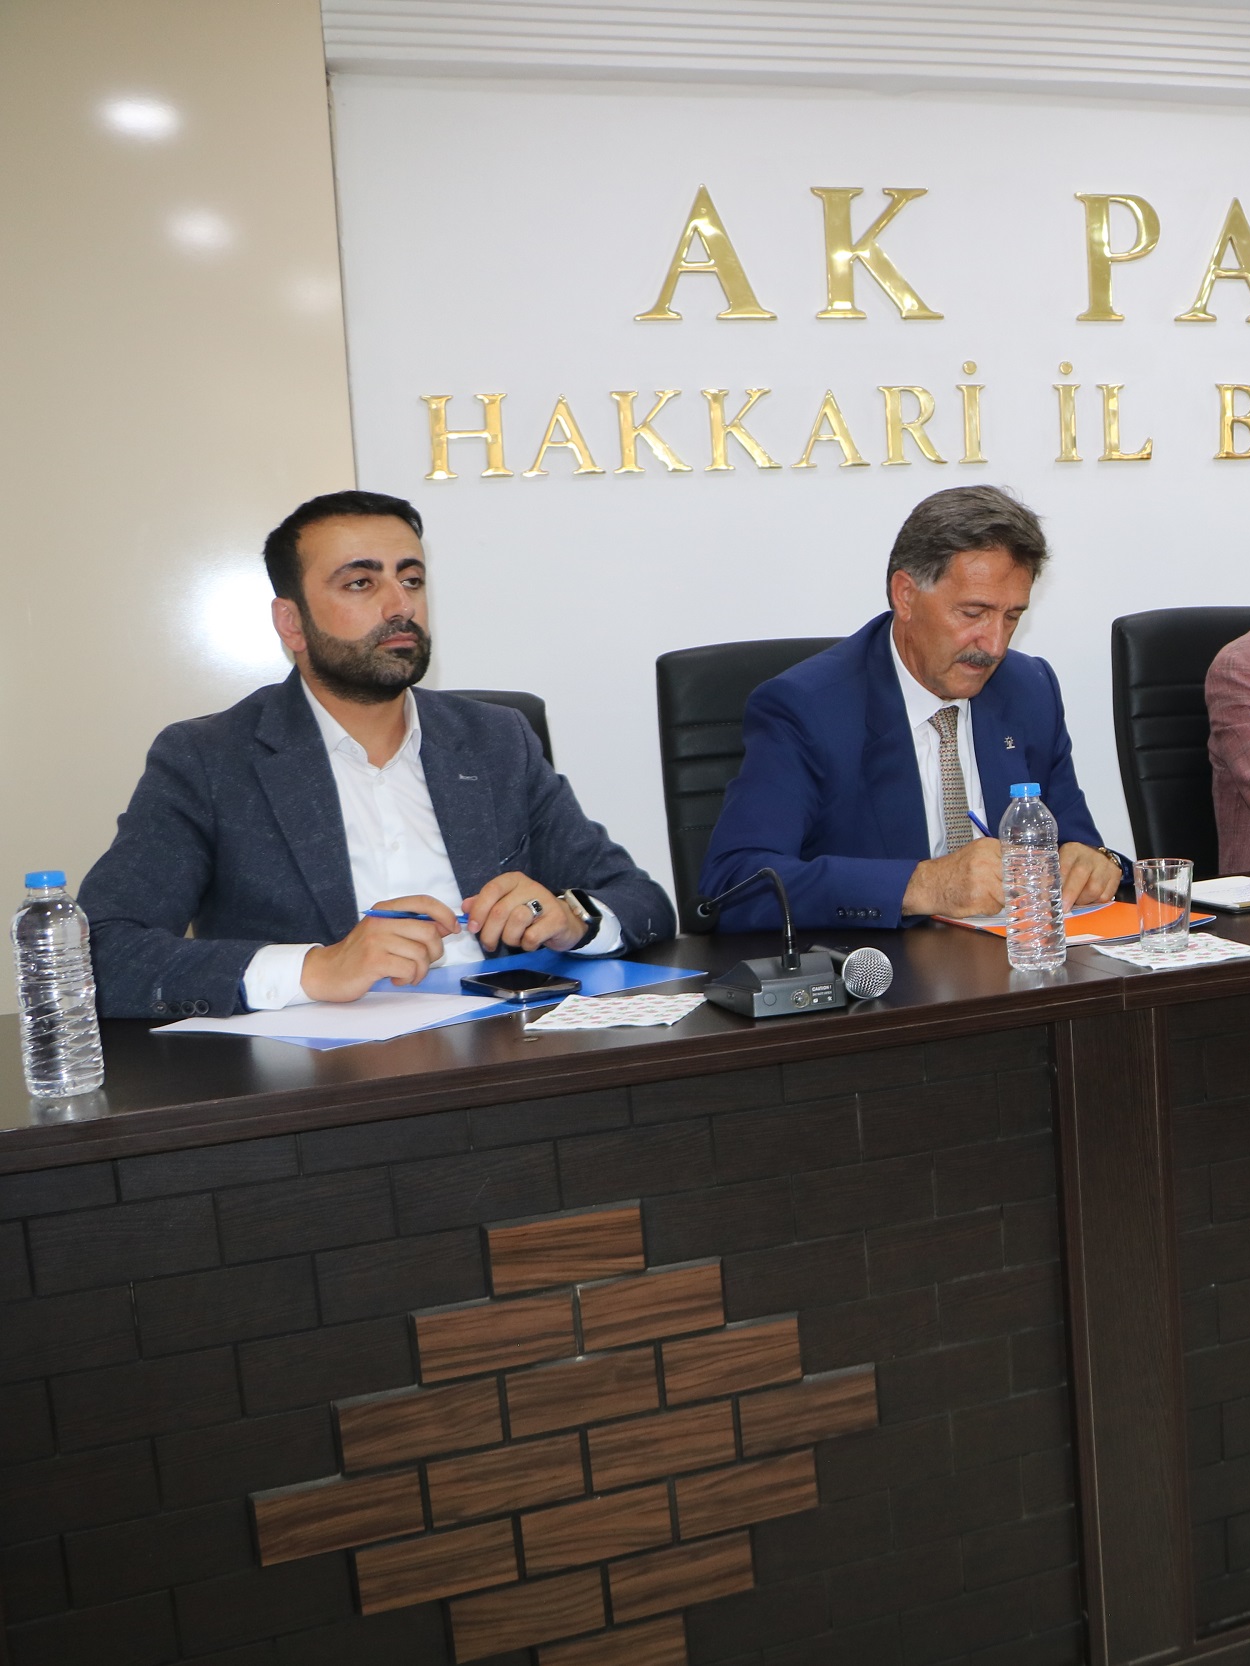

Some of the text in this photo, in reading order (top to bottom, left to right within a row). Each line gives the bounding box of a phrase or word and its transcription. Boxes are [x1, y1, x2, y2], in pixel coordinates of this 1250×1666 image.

[634, 183, 944, 320] AK
[419, 360, 988, 480] HAKKARİ
[1052, 361, 1155, 463] İL
